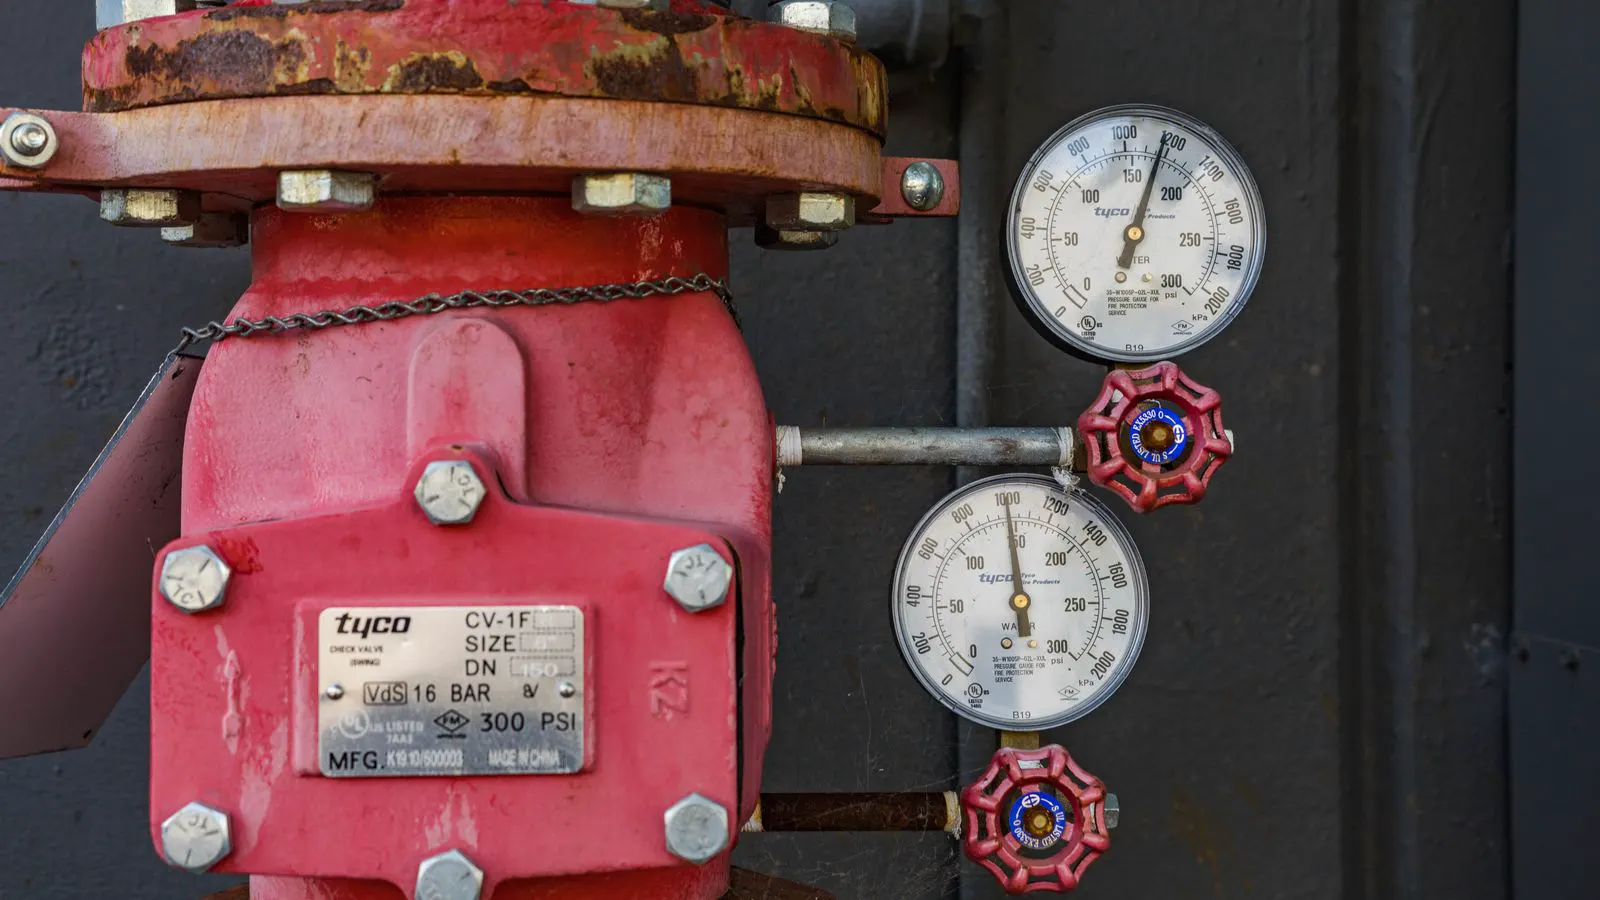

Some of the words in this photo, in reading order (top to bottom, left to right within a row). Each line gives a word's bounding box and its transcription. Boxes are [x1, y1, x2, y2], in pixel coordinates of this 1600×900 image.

[1111, 125, 1137, 140] 1000
[1067, 136, 1090, 156] 800
[1123, 169, 1142, 183] 150
[1199, 155, 1224, 182] 1400
[1033, 169, 1054, 192] 600
[1082, 189, 1100, 203] 100
[1161, 187, 1182, 201] 200
[1094, 207, 1130, 218] tyco
[1224, 198, 1244, 225] 1600
[1021, 217, 1036, 239] 400
[1064, 232, 1078, 246] 50
[1180, 233, 1200, 247] 250
[1227, 245, 1244, 271] 1800
[1026, 263, 1045, 287] 200
[1161, 274, 1182, 288] 300
[1084, 277, 1091, 291] 0
[1165, 291, 1177, 299] psi
[1204, 286, 1230, 315] 2000
[1055, 306, 1066, 317] 0
[1125, 344, 1144, 352] B19
[995, 491, 1020, 506] 1000
[1043, 495, 1069, 516] 1200
[951, 503, 974, 524] 800
[1082, 520, 1107, 547] 1400
[918, 537, 938, 560] 600
[966, 556, 984, 570] 100
[1045, 552, 1066, 566] 200
[1108, 561, 1127, 589] 1600
[907, 585, 921, 607] 400
[950, 599, 964, 613] 50
[1065, 598, 1086, 612] 250
[335, 612, 411, 639] tyco
[465, 611, 531, 629] CV-1F
[1001, 622, 1036, 630] WAR
[1112, 609, 1130, 635] 1800
[465, 635, 516, 652] SIZE
[912, 632, 931, 655] 200
[970, 644, 977, 658] 0
[1047, 640, 1068, 654] 300
[465, 659, 497, 676] DN
[1051, 657, 1064, 665] psi
[1090, 650, 1116, 680] 2000
[942, 674, 953, 686] 0
[366, 684, 406, 702] VdS
[414, 684, 436, 702] 16
[451, 684, 490, 702] BAR
[481, 713, 525, 732] 300
[541, 712, 576, 731] PSI
[1012, 710, 1031, 719] B19
[329, 752, 385, 770] MFG.
